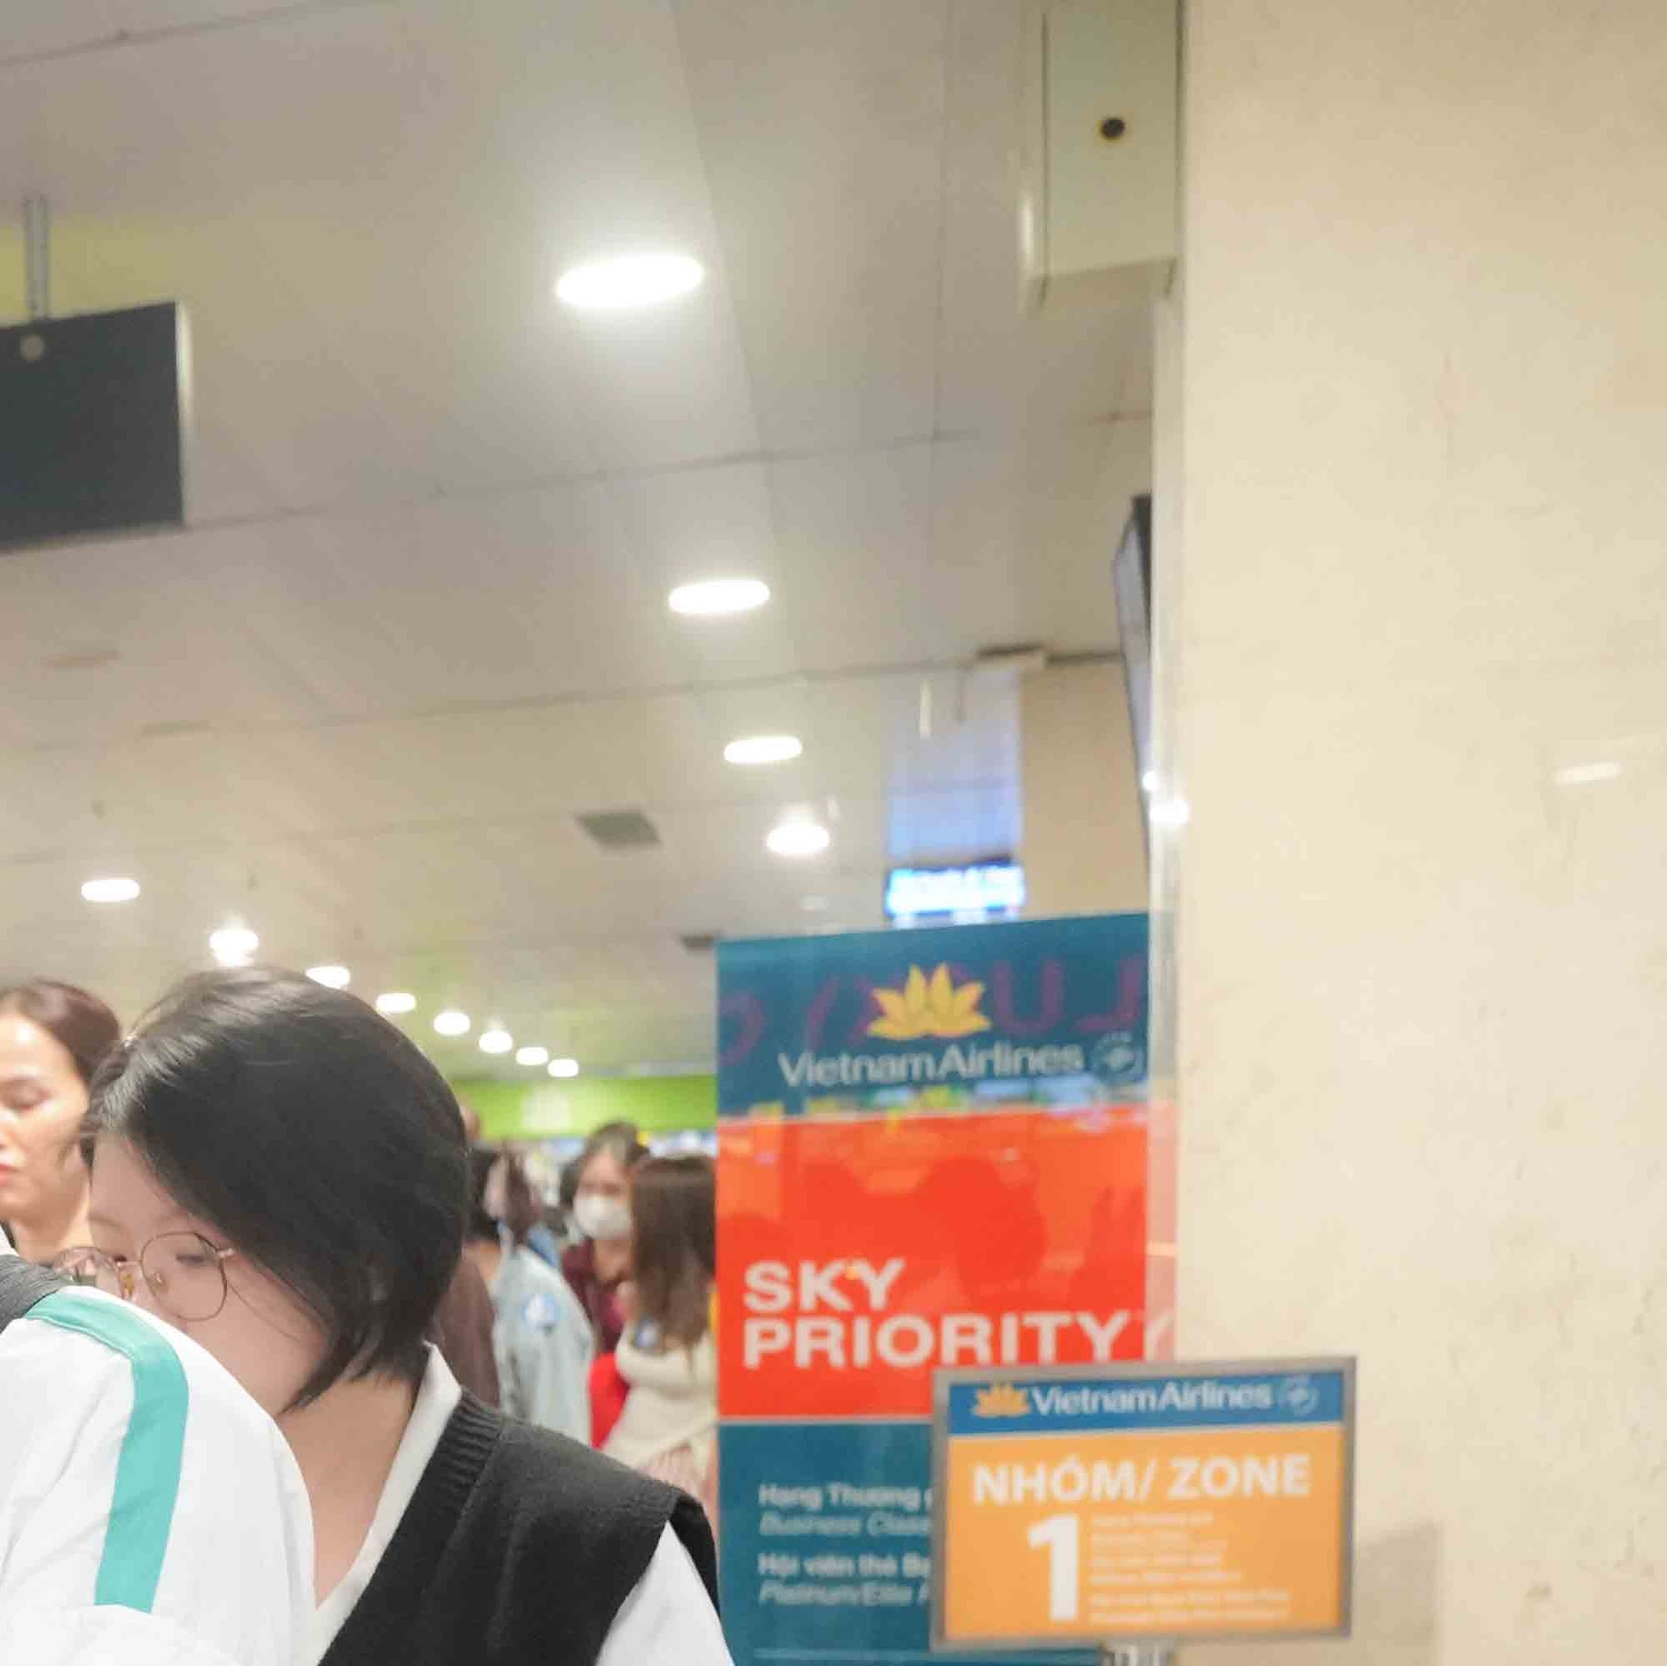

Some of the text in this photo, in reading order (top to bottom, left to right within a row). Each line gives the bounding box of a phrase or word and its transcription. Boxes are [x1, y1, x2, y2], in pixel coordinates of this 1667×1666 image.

[743, 1257, 905, 1312] SKY
[742, 1310, 1131, 1369] PRIORITY
[1168, 1452, 1312, 1499] ZONE
[1026, 1512, 1080, 1622] 1
